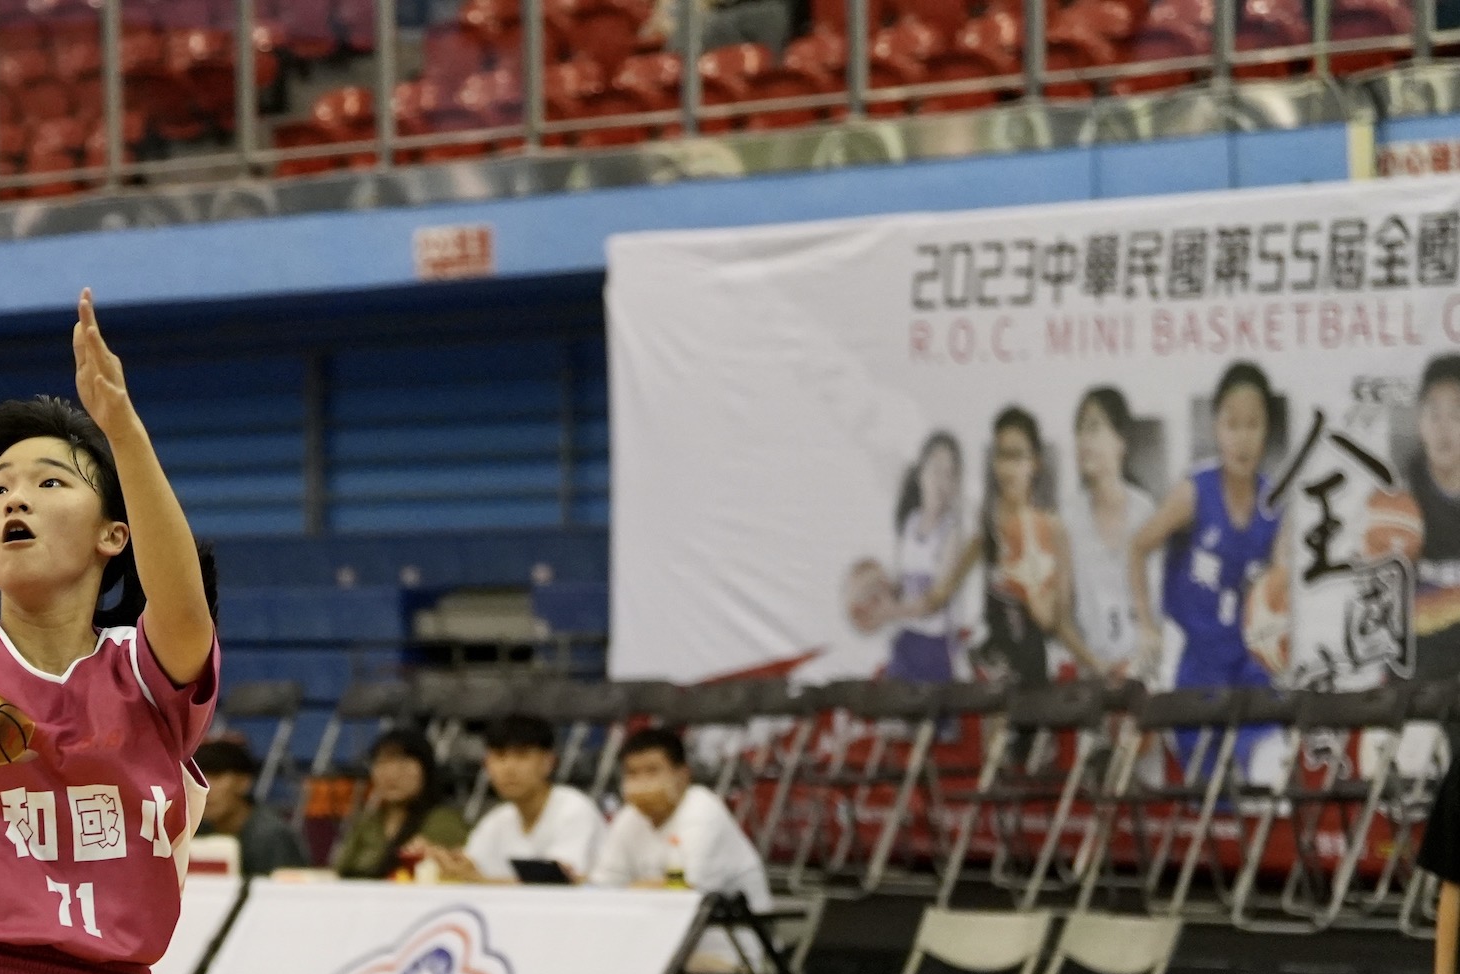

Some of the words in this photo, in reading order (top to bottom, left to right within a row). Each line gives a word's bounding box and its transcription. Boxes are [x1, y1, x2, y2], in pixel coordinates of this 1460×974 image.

[1044, 309, 1134, 357] MINI
[1151, 299, 1422, 358] BASKETBALL
[45, 874, 103, 938] 71
